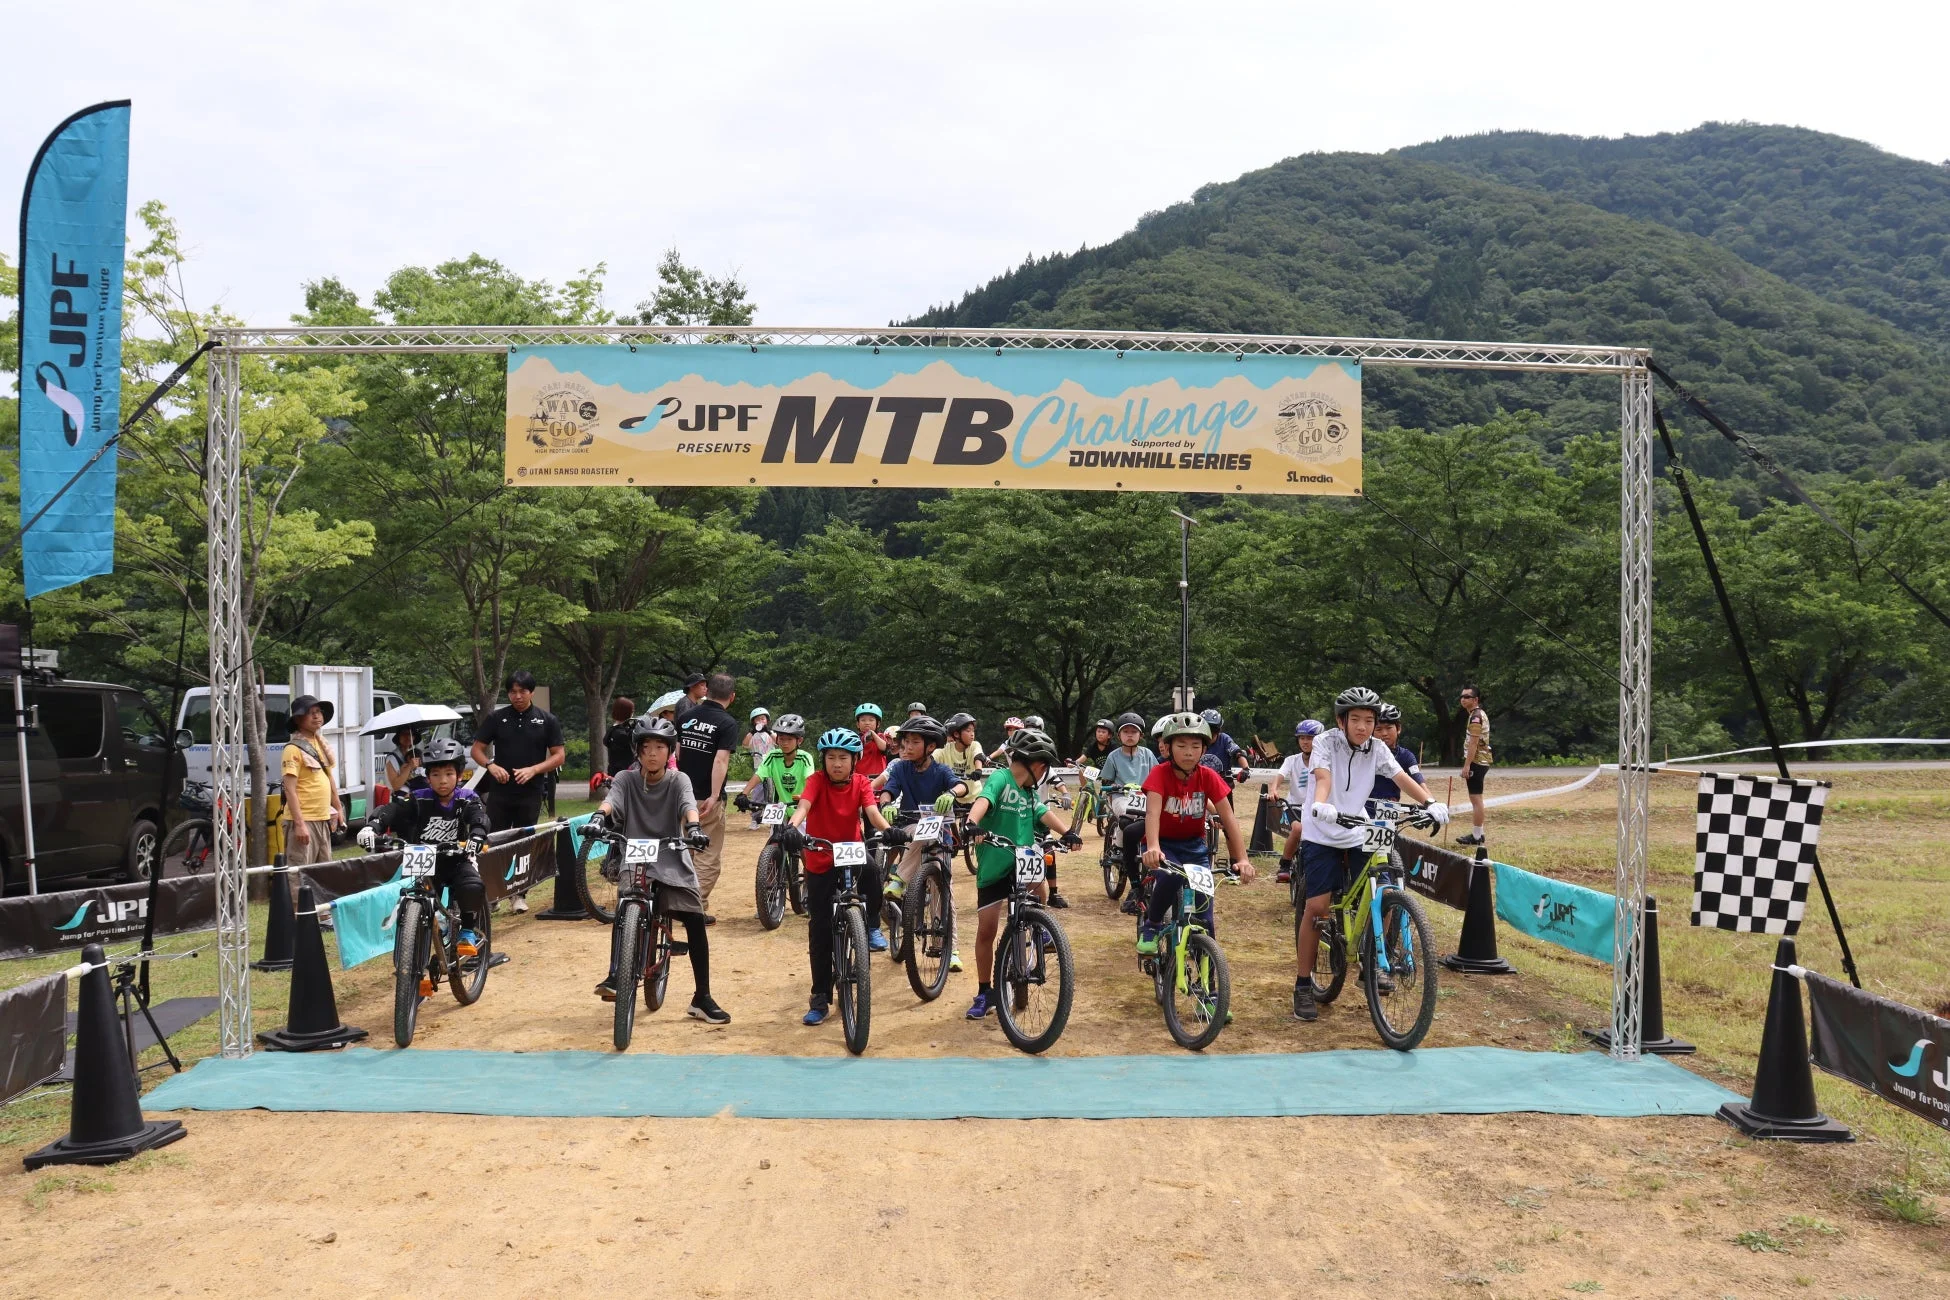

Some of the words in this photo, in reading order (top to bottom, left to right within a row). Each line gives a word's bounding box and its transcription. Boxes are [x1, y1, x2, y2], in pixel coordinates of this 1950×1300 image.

[49, 252, 89, 367] JPF
[93, 371, 102, 393] for
[91, 395, 104, 432] Jump
[547, 400, 580, 412] WAY
[1296, 405, 1324, 420] WAY
[678, 404, 763, 432] JPF
[549, 421, 577, 437] GO
[761, 396, 1014, 465] MTB
[1012, 395, 1258, 469] Challenge
[1299, 428, 1322, 445] GO
[676, 443, 752, 453] PRESENTS
[1131, 439, 1181, 448] Supported
[1183, 441, 1195, 449] by
[1069, 450, 1176, 469] DOWNHILL
[1178, 453, 1252, 471] SERIES
[581, 467, 619, 475] ROASTERY
[1287, 471, 1299, 482] SL
[1300, 475, 1333, 483] media
[694, 722, 717, 734] JPF
[682, 739, 707, 749] STAFF
[764, 809, 784, 820] 230
[916, 821, 940, 836] 279
[1365, 828, 1393, 847] 248
[627, 844, 657, 858] 250
[835, 846, 865, 860] 246
[405, 852, 434, 869] 245
[1019, 857, 1043, 876] 243
[60, 933, 82, 941] Jump
[96, 926, 126, 936] Positive
[127, 924, 146, 932] Futur
[1893, 1081, 1917, 1100] Jump
[1918, 1092, 1932, 1105] for
